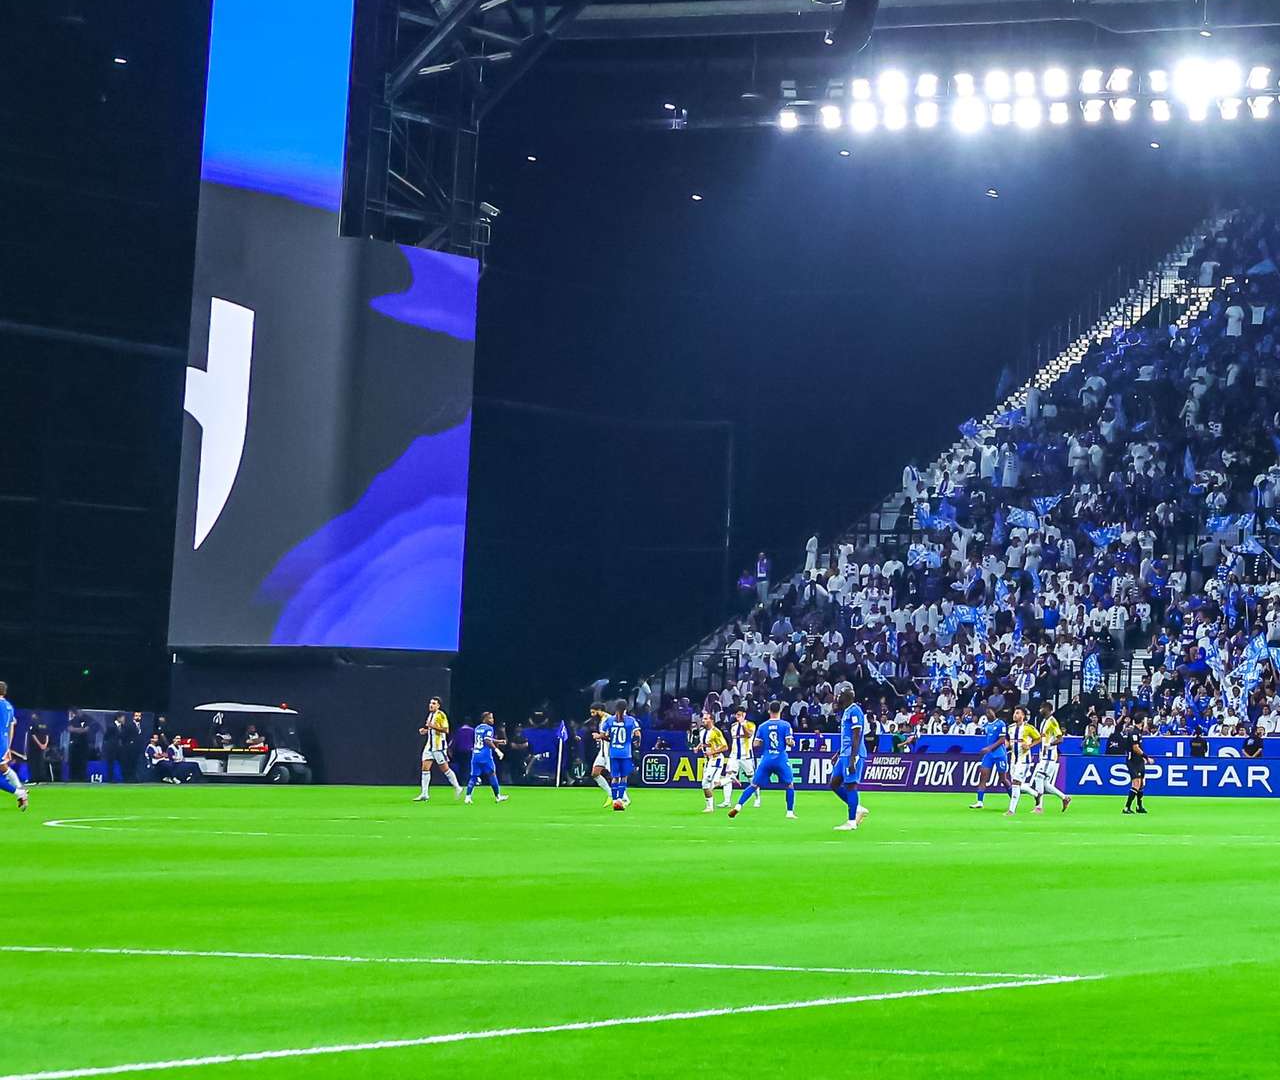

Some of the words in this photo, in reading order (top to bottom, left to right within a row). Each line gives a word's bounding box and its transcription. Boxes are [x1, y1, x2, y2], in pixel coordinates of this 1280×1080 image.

[610, 727, 626, 743] 70
[808, 758, 833, 784] AP
[864, 766, 906, 780] FANTASY
[913, 760, 958, 786] PICK
[1078, 763, 1273, 793] ASPETAR
